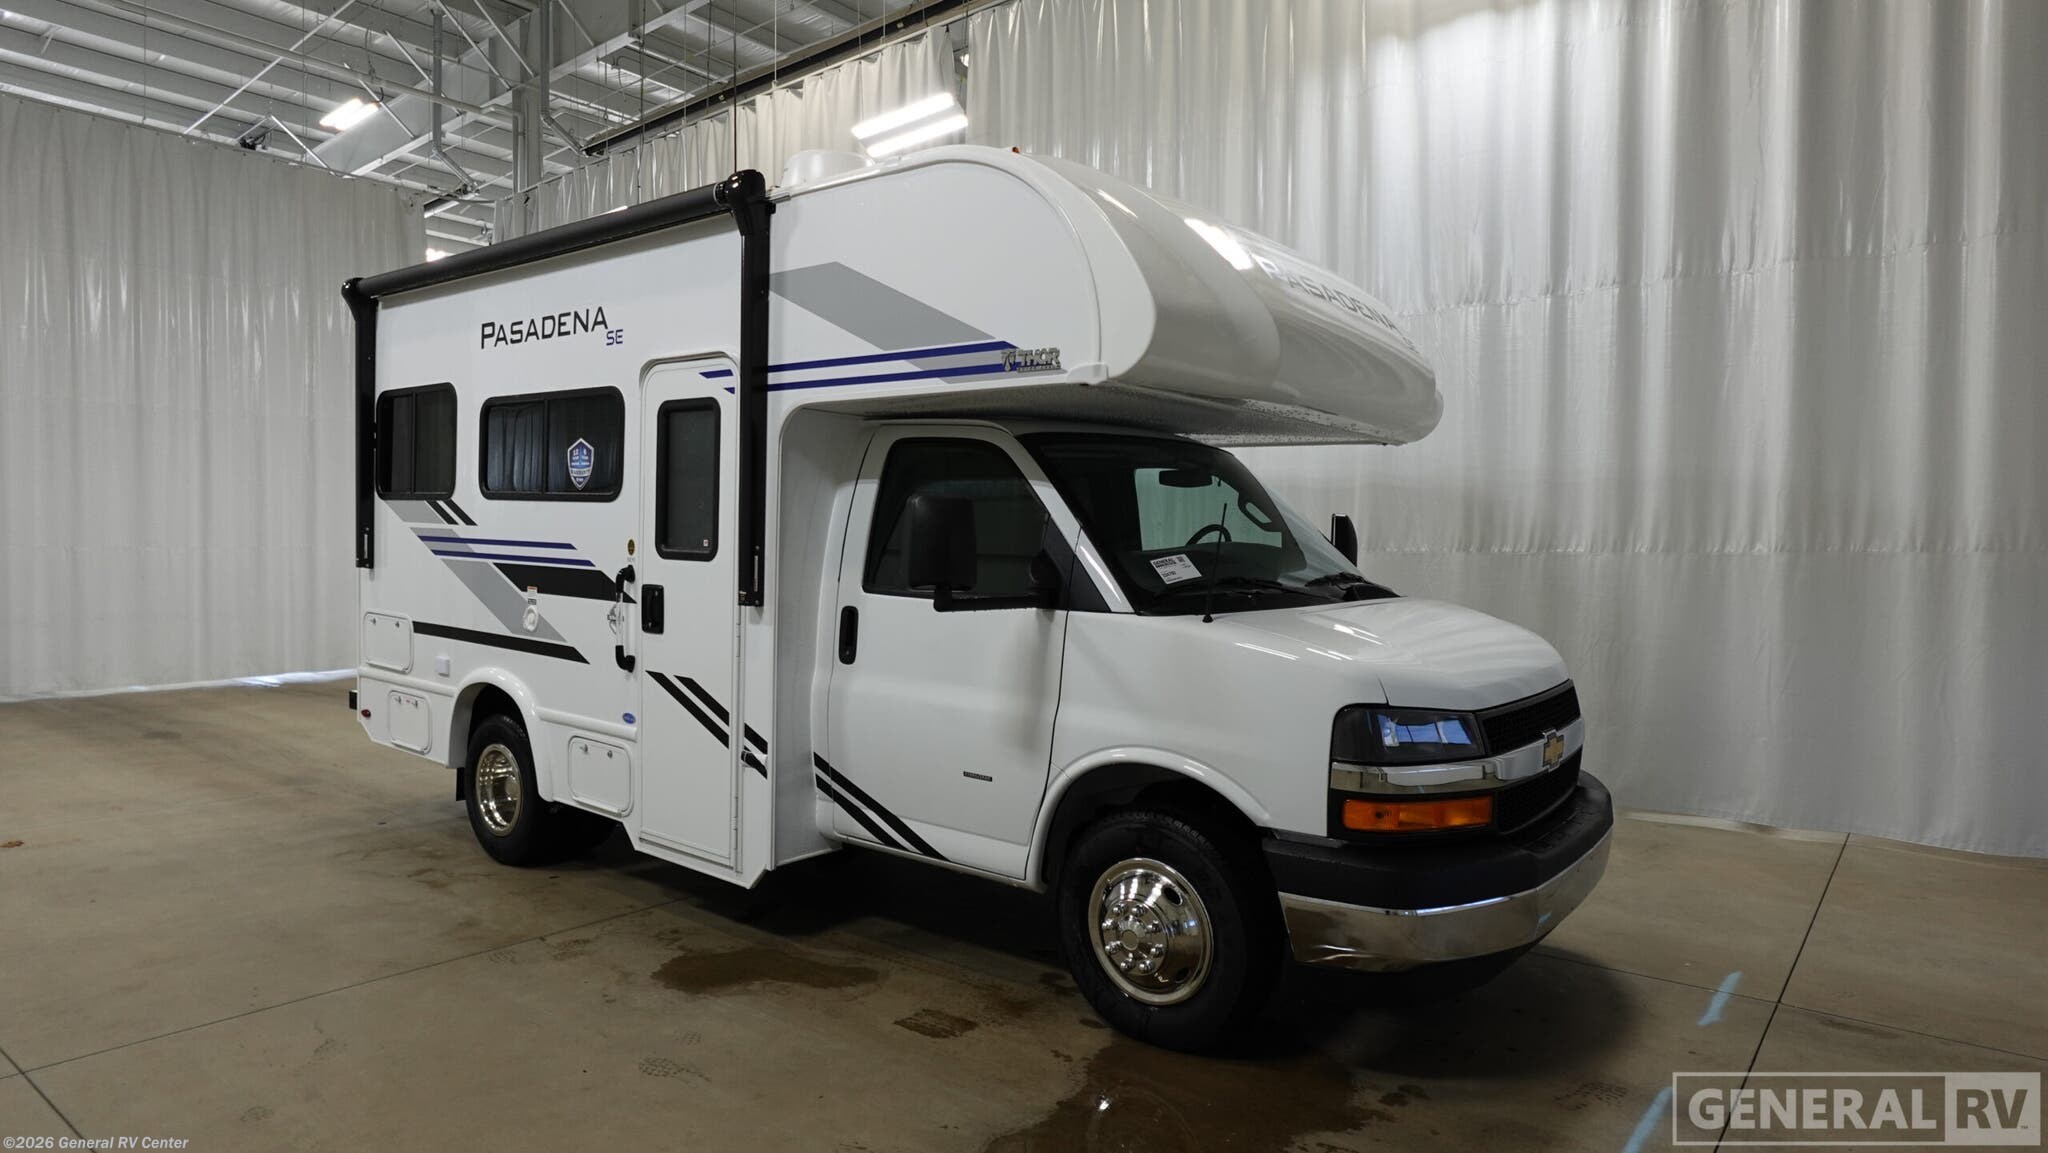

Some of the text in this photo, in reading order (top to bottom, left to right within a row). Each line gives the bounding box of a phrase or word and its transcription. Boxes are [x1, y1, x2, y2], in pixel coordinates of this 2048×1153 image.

[481, 306, 624, 349] PASADENA SE
[1018, 347, 1061, 368] THOR
